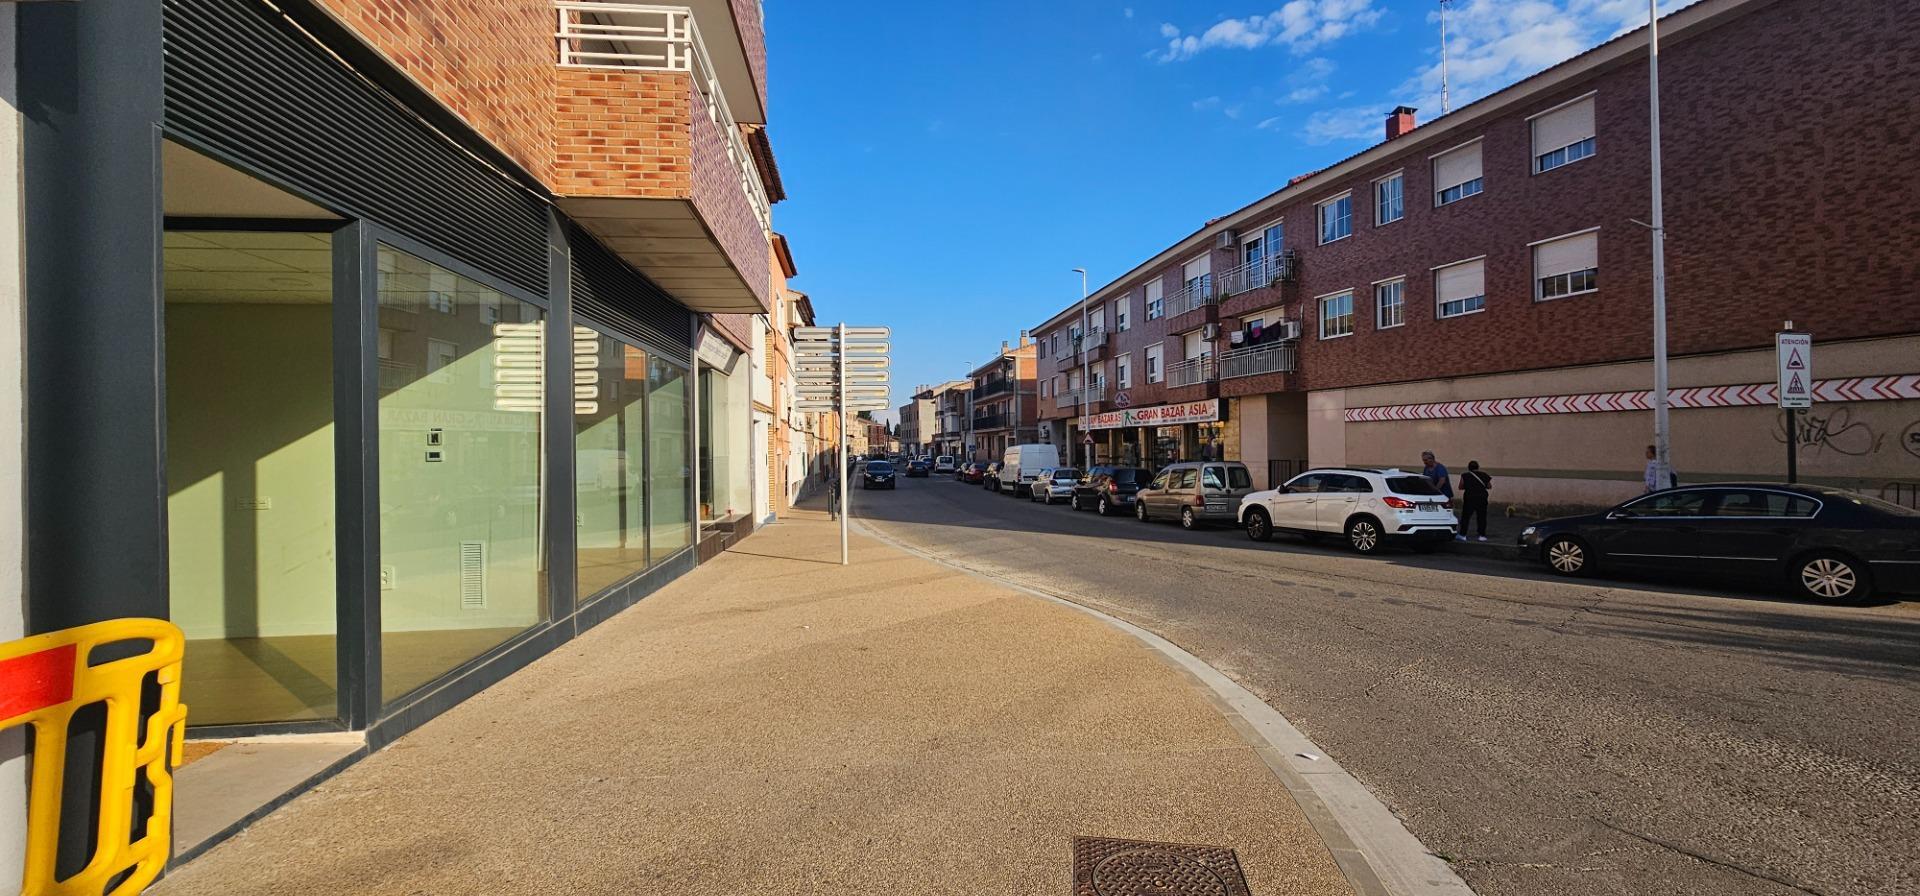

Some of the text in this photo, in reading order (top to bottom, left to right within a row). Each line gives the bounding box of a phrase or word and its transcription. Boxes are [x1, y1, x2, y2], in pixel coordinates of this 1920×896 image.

[1137, 409, 1158, 420] GRAN
[1161, 406, 1185, 419] BAZAR
[1188, 402, 1208, 416] ASIA
[1098, 414, 1114, 423] BAZAR
